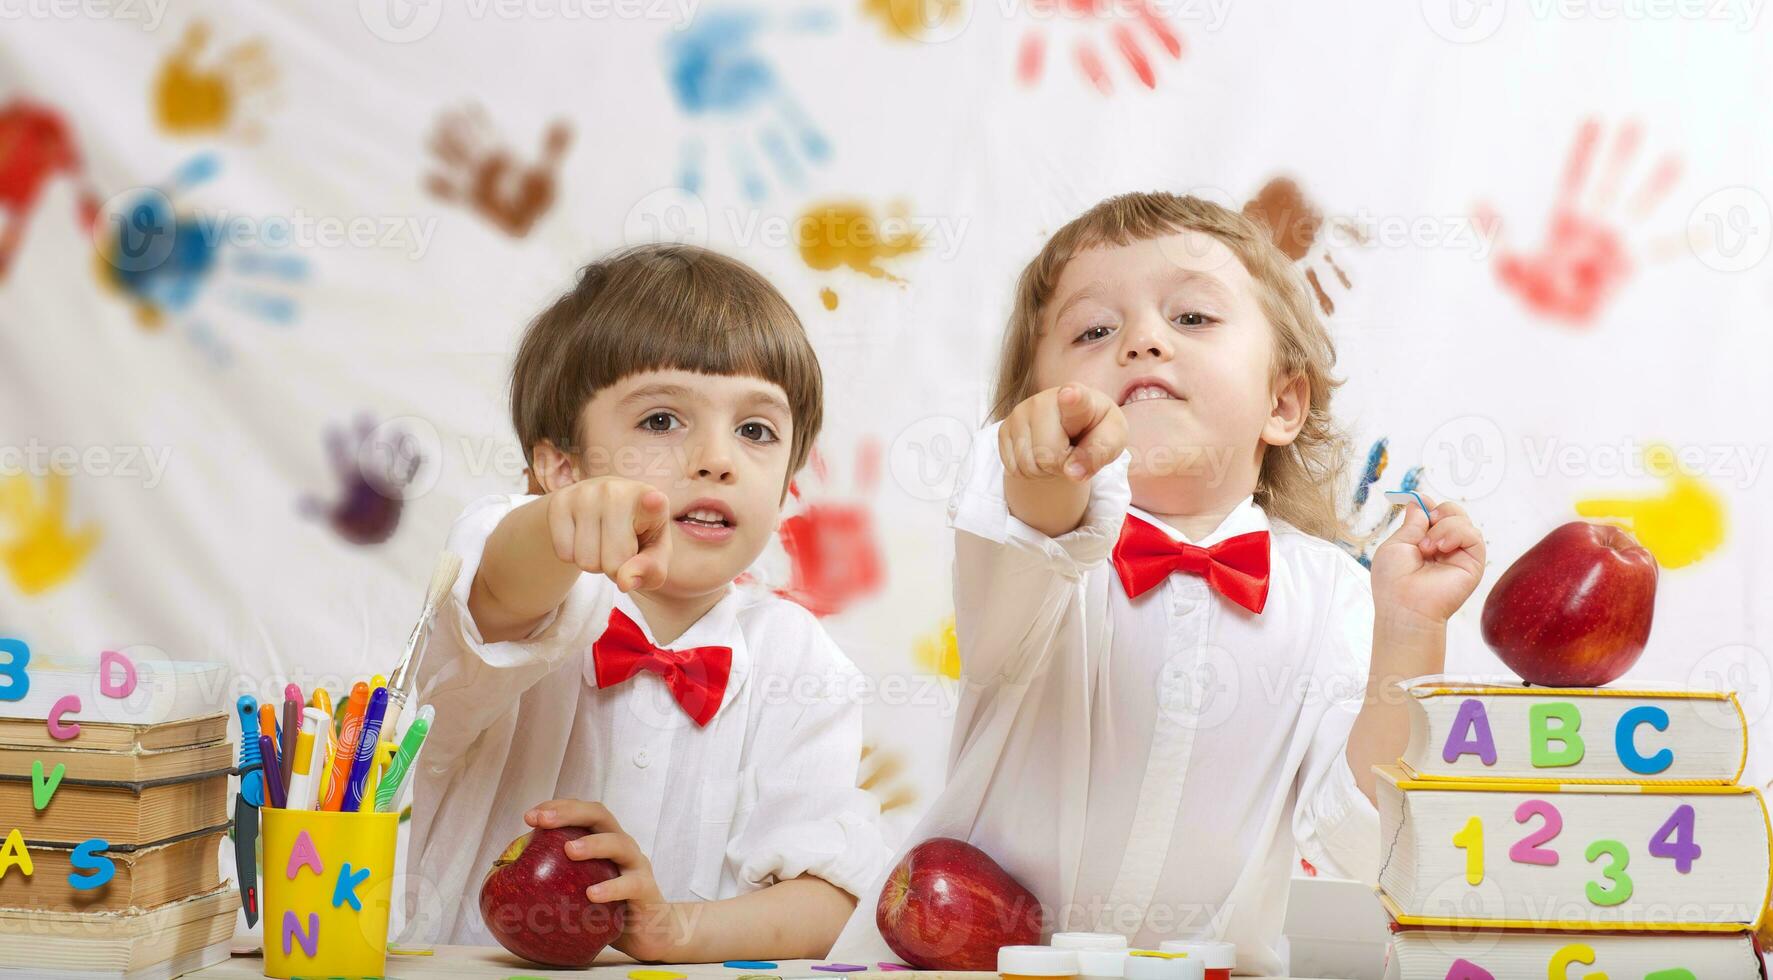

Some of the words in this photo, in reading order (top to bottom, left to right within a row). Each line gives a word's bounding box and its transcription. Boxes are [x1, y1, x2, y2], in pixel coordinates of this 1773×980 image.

[0, 638, 30, 701] B
[101, 650, 137, 698] D
[48, 695, 81, 740] C
[32, 760, 65, 811] V
[0, 828, 34, 879] A
[68, 838, 116, 890] S
[286, 831, 323, 880] A
[1453, 816, 1484, 885] 1
[1509, 800, 1563, 866] 2
[1585, 839, 1633, 906] 3
[1648, 804, 1701, 874] 4
[332, 863, 370, 911] K
[282, 911, 319, 957] N
